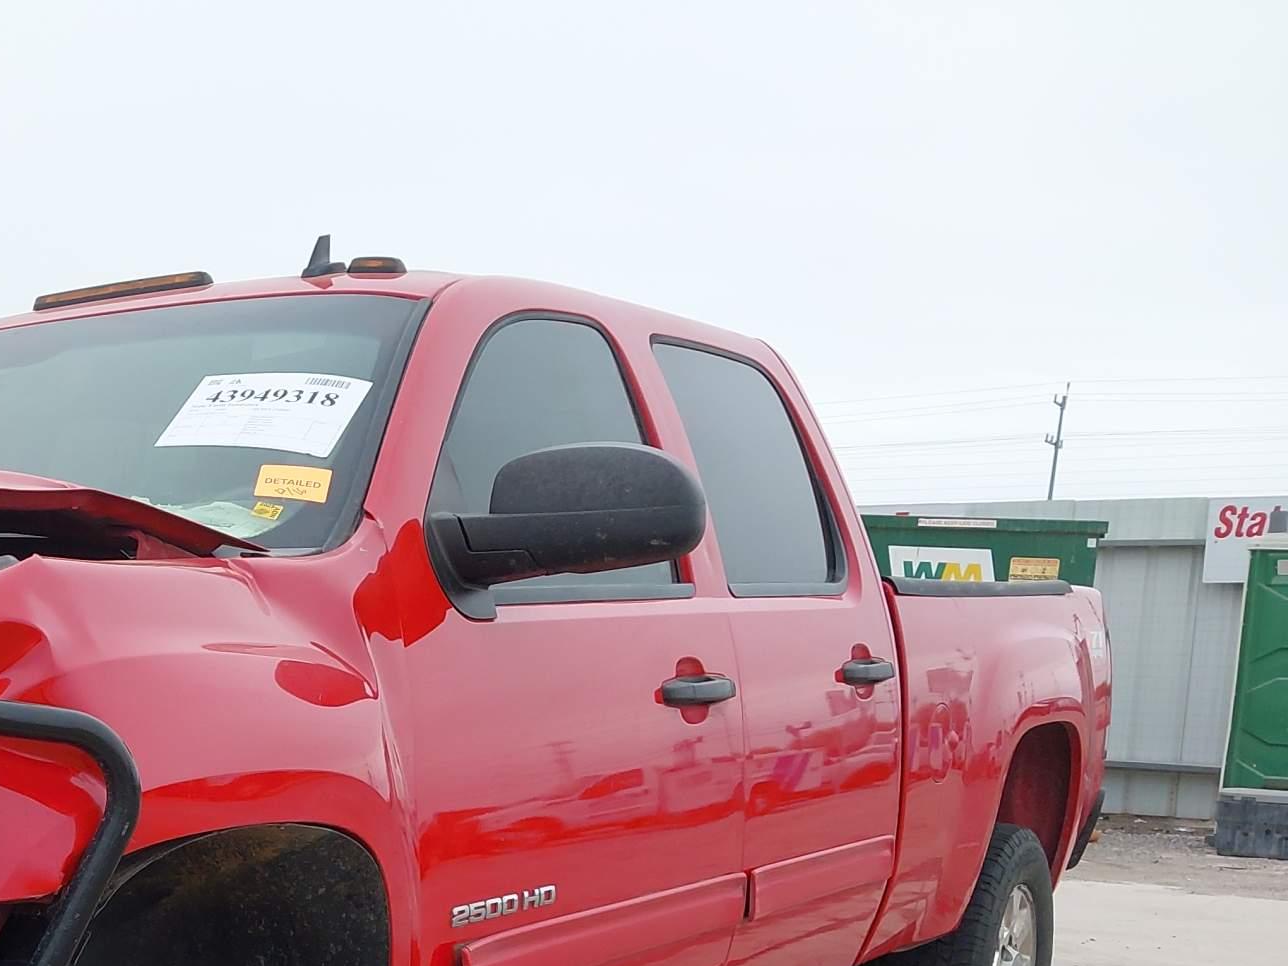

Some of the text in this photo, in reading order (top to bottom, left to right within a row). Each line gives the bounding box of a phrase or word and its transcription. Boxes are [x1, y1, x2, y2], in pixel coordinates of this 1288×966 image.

[206, 389, 340, 407] 43949318
[264, 477, 322, 489] DETAILED
[1214, 505, 1282, 538] Sta
[903, 560, 983, 582] WM
[452, 885, 556, 928] 2500 HD
